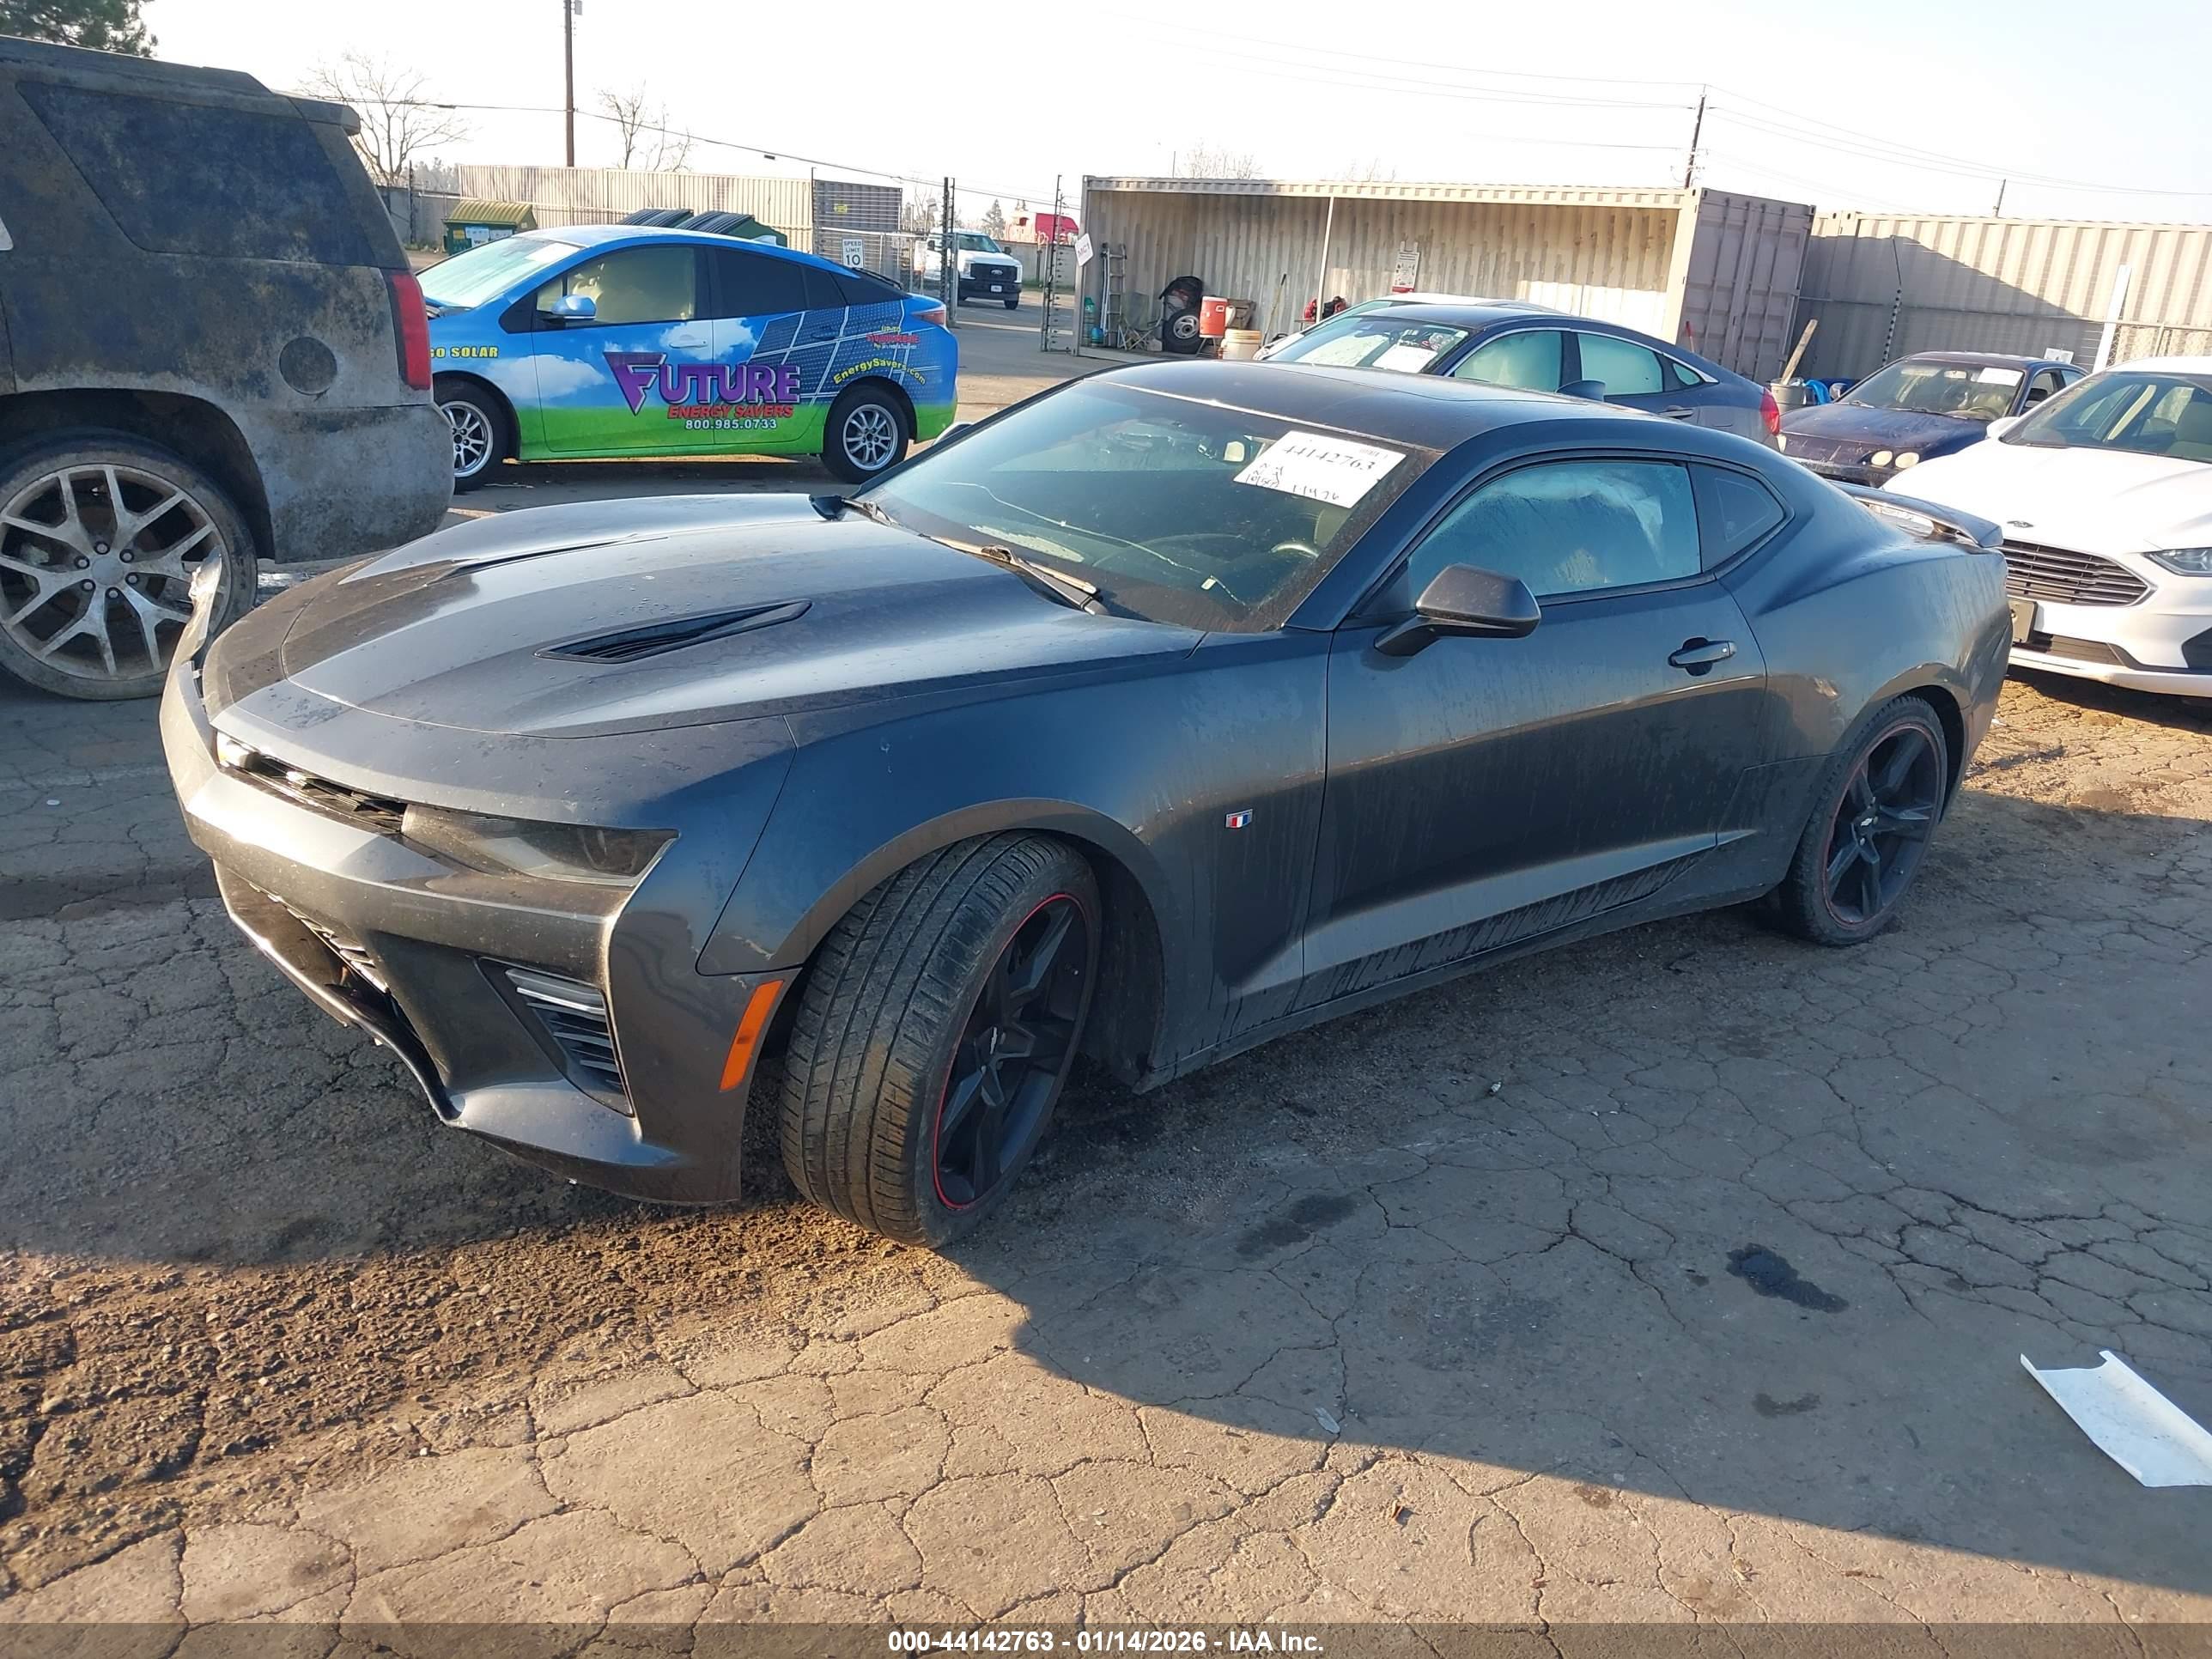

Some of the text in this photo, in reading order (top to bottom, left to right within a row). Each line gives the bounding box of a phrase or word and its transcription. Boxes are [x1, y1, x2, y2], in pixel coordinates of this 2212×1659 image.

[846, 254, 860, 265] 10
[451, 346, 499, 358] SOLAR
[833, 357, 927, 386] EnergySavers.com
[603, 351, 800, 416] FUTURE
[667, 404, 794, 419] ENERGY SAVERS
[685, 418, 777, 430] 800.985.0733
[1284, 445, 1376, 470] 44142763
